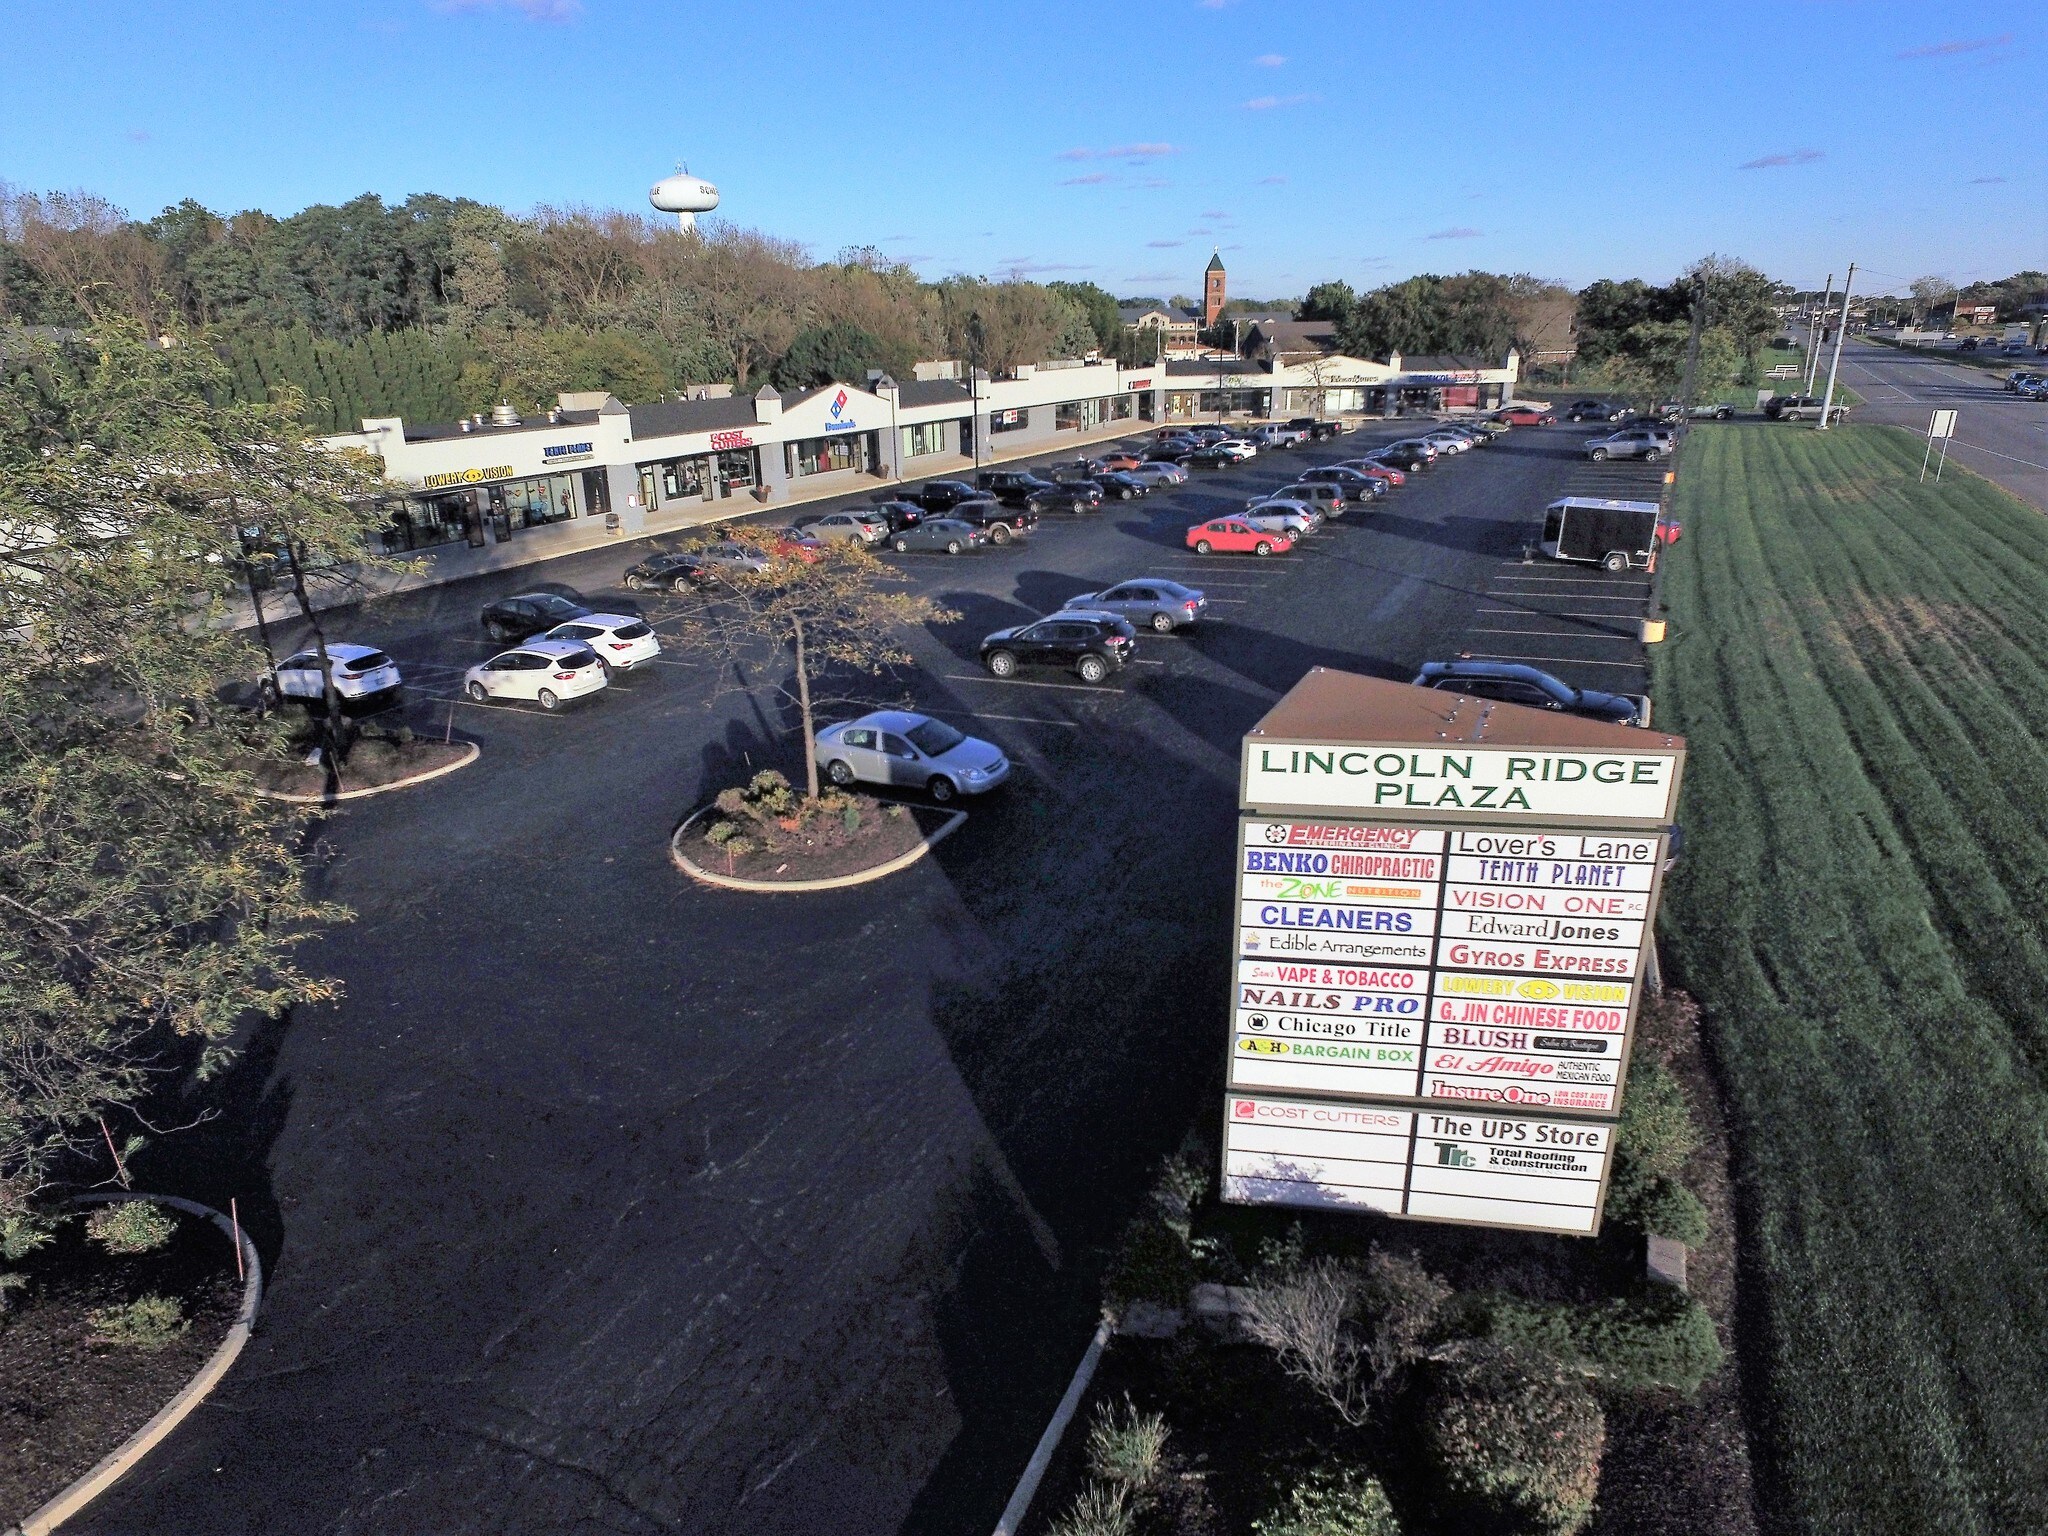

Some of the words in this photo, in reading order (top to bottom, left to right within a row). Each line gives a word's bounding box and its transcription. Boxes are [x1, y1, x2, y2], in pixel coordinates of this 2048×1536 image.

[711, 437, 753, 450] CUTTERS
[718, 430, 744, 441] COST
[424, 471, 463, 488] LOWERY
[482, 465, 513, 480] VISION
[1261, 750, 1473, 778] LINCOLN
[1506, 757, 1662, 785] RIDGE
[1374, 783, 1531, 809] PLAZA
[1287, 824, 1421, 845] EMERGENCY
[1459, 832, 1556, 856] Lover's
[1579, 836, 1649, 860] Lane
[1247, 851, 1328, 873] BENKO
[1331, 854, 1435, 878] CHIROPRACTIC
[1480, 860, 1539, 882] TENTH
[1552, 863, 1626, 886] PLANET
[1260, 879, 1283, 888] the
[1348, 887, 1421, 897] NUTRITION
[1452, 890, 1545, 910] VISION
[1565, 896, 1625, 914] ONE
[1261, 906, 1412, 932] CLEANERS
[1466, 915, 1548, 937] Edward
[1550, 920, 1619, 940] Jones
[1270, 934, 1317, 951] Edible
[1320, 940, 1426, 957] Arrangements
[1277, 966, 1316, 983] VAPE
[1322, 969, 1333, 984] &
[1338, 970, 1413, 988] TOBACCO
[1442, 976, 1516, 995] LOWERY
[1563, 983, 1626, 1002] VISION
[1242, 989, 1341, 1009] NAILS
[1352, 995, 1419, 1014] PRO
[1278, 1016, 1356, 1037] Chicago
[1366, 1021, 1411, 1038] Title
[1440, 1001, 1456, 1020] G.
[1461, 1003, 1488, 1023] JIN
[1493, 1004, 1568, 1028] CHINESE
[1572, 1009, 1621, 1031] FOOD
[1444, 1028, 1528, 1049] BLUSH
[1247, 1040, 1258, 1051] A
[1270, 1042, 1281, 1053] H
[1293, 1044, 1370, 1060] BARGAIN
[1377, 1050, 1414, 1062] BOX
[1434, 1054, 1463, 1069] El
[1466, 1056, 1554, 1077] Amigo
[1557, 1061, 1600, 1072] AUTHENTIC
[1556, 1071, 1589, 1082] MEXICAN
[1591, 1072, 1611, 1083] FOOD
[1553, 1097, 1606, 1108] INSURANCE
[1554, 1090, 1569, 1098] LOW
[1571, 1091, 1588, 1099] COST
[1590, 1092, 1608, 1100] AUTO
[1257, 1105, 1308, 1120] COST
[1313, 1110, 1400, 1127] CUTTERS
[1431, 1116, 1472, 1136] The
[1481, 1120, 1527, 1140] UPS
[1536, 1125, 1599, 1147] Store
[1489, 1156, 1499, 1165] &
[1502, 1157, 1587, 1172] Construction
[1490, 1147, 1522, 1158] Total
[1525, 1150, 1575, 1163] Roofing
